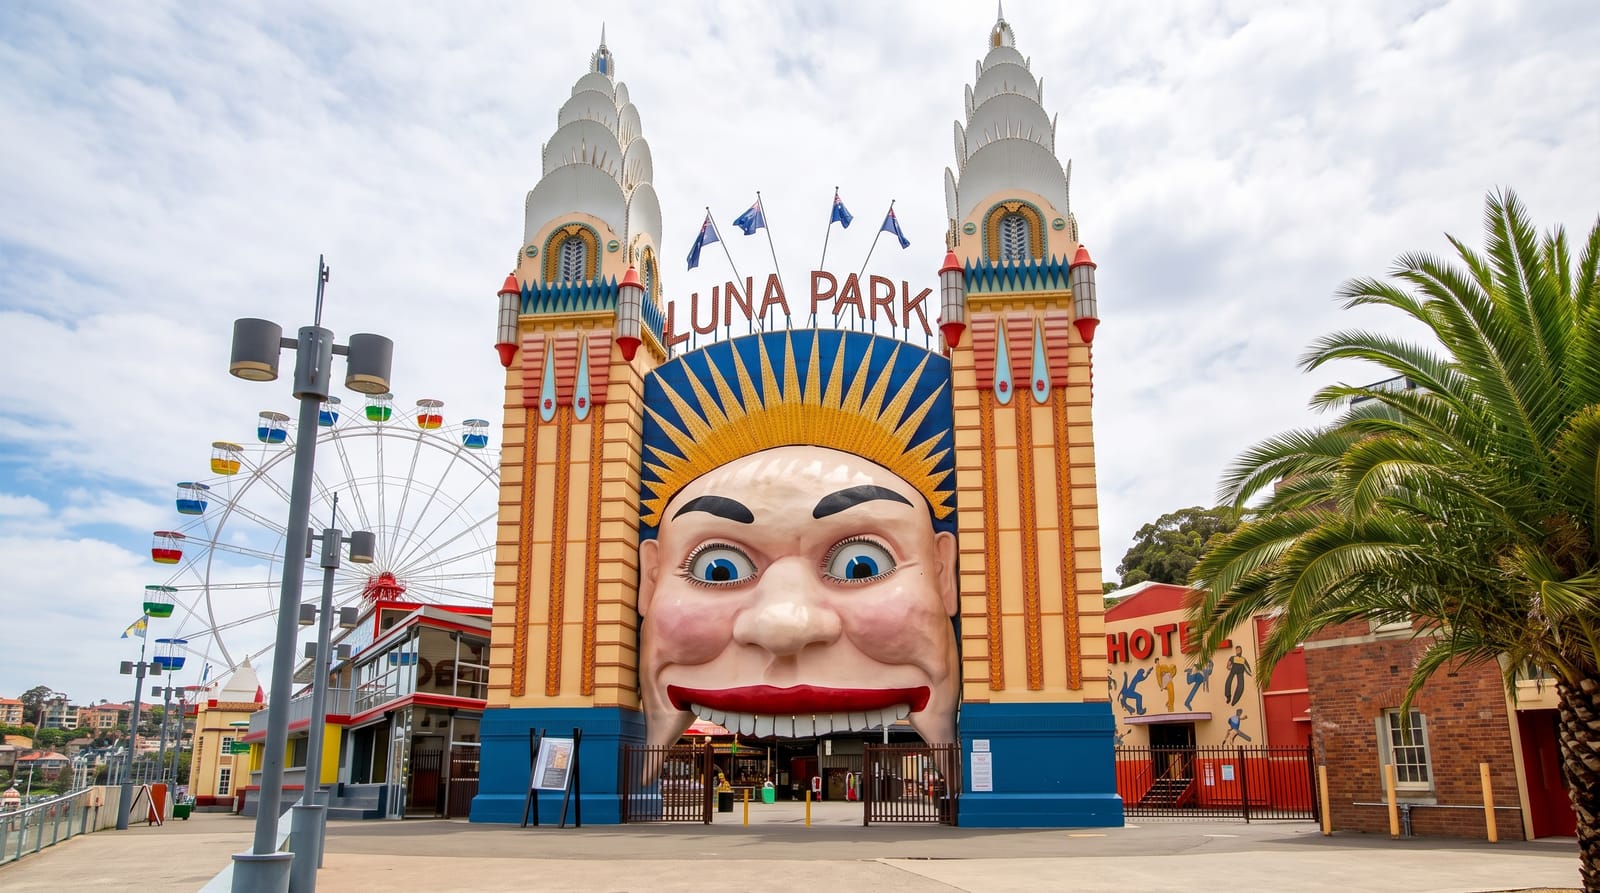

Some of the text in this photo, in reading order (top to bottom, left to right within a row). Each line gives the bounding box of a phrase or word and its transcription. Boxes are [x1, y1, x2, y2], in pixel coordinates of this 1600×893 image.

[666, 270, 933, 346] LUNA PARK
[1106, 621, 1232, 664] HOTE
